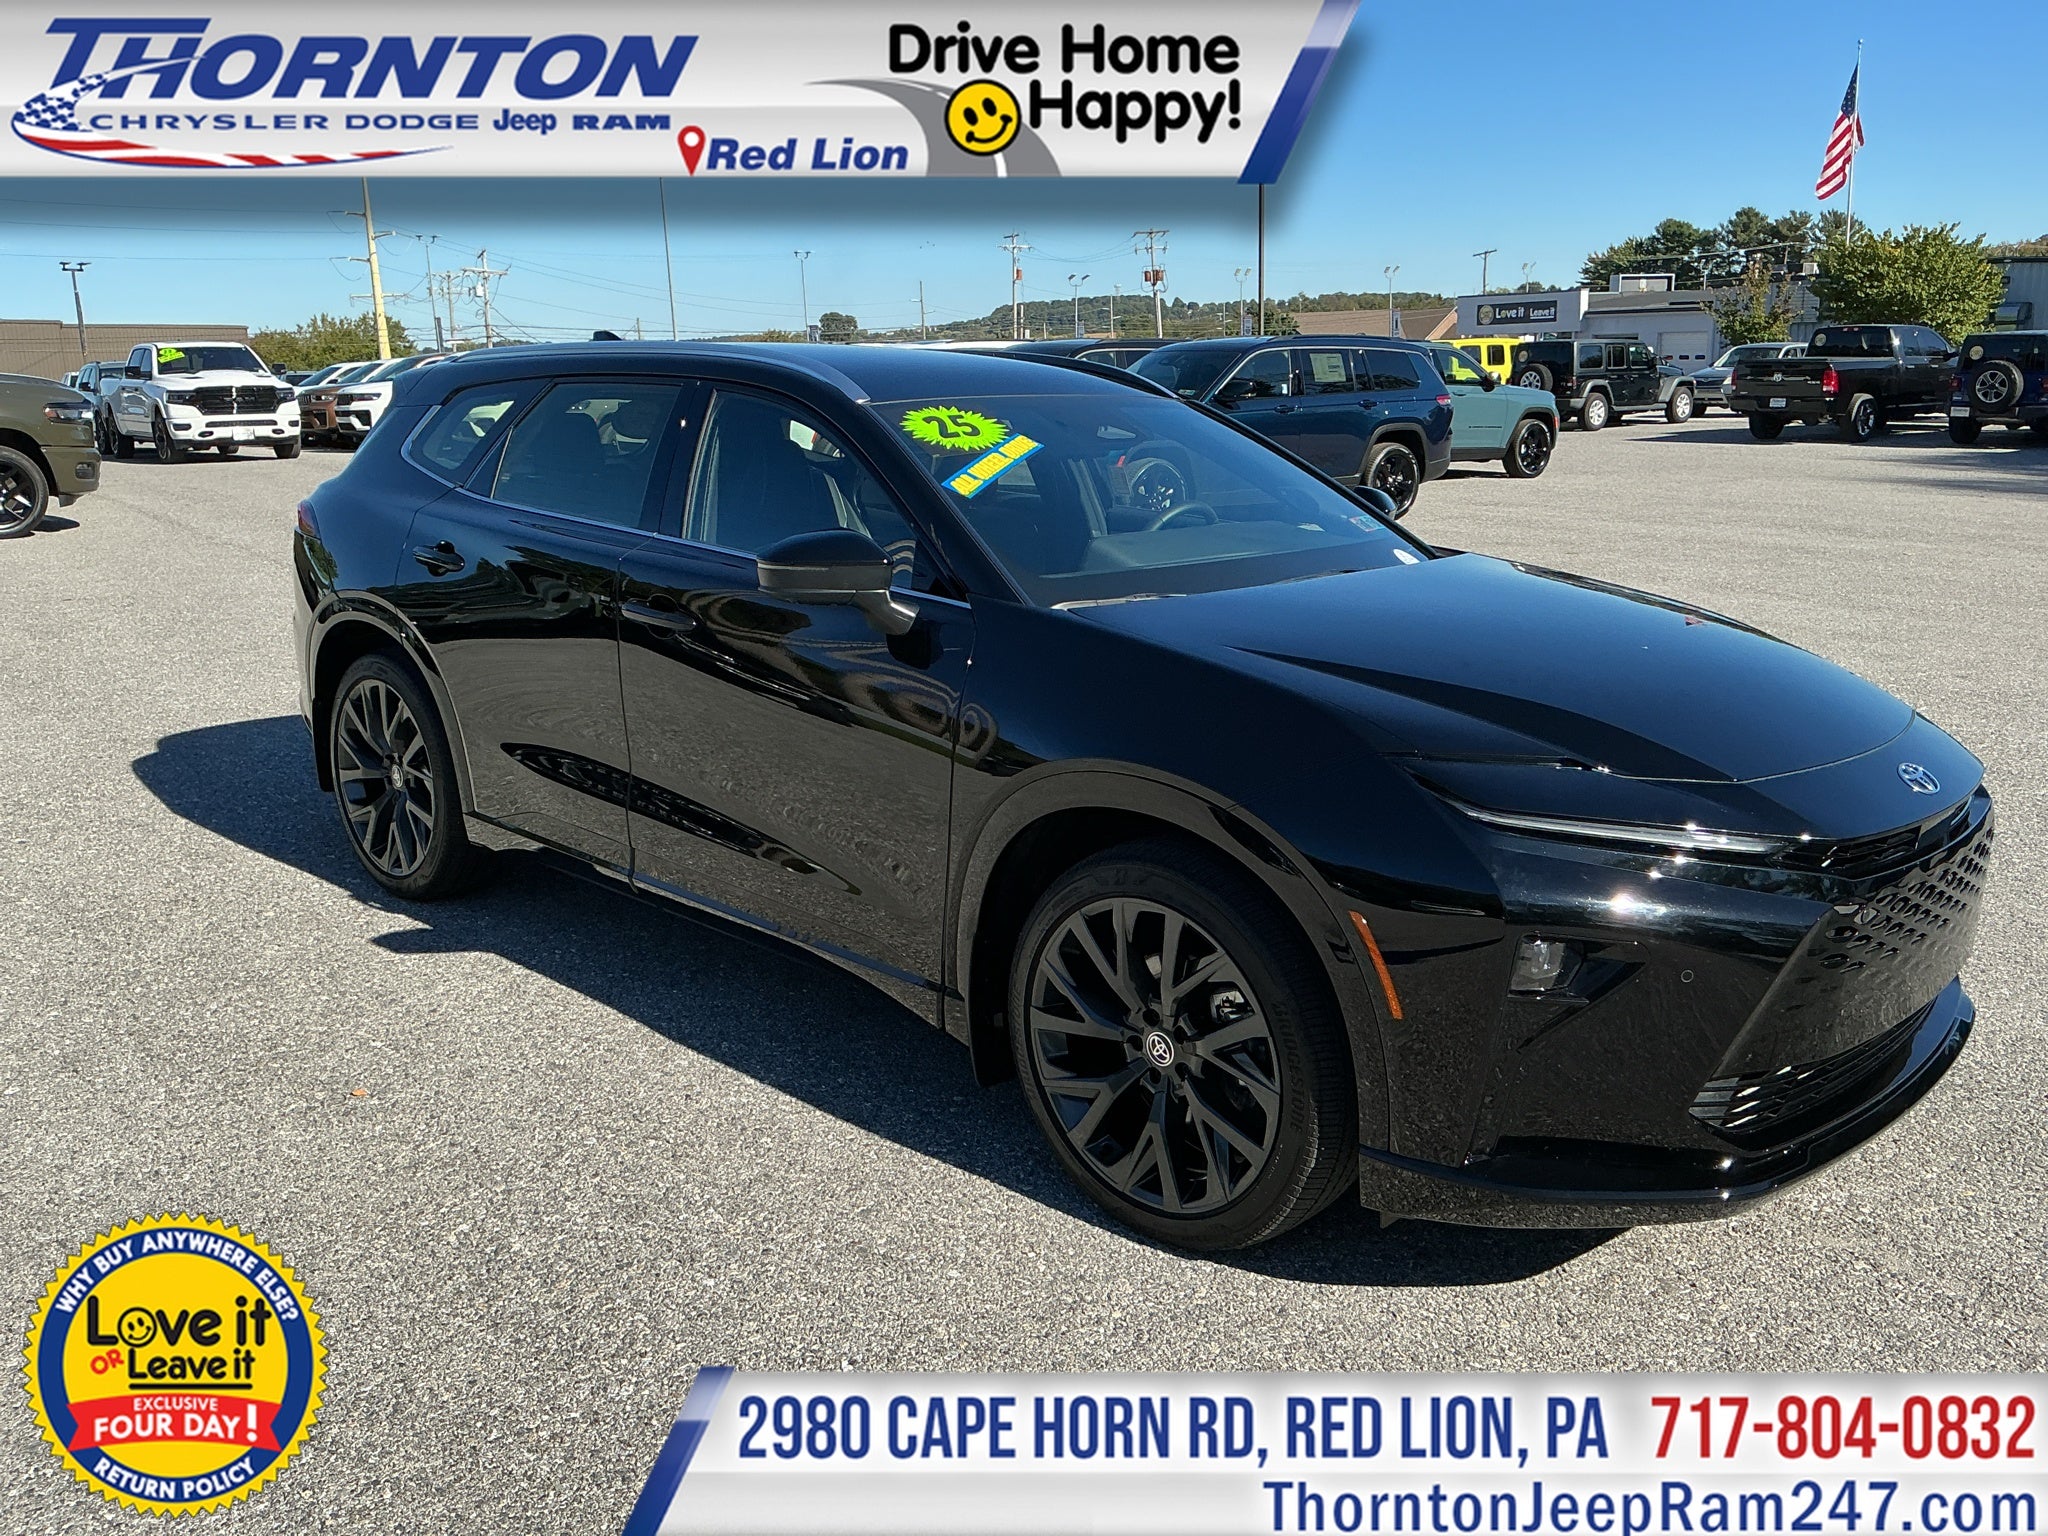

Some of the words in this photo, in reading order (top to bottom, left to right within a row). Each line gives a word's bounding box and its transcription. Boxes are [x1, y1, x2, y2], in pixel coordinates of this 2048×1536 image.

[1495, 307, 1517, 319] Love
[1518, 306, 1525, 318] it
[1529, 307, 1549, 318] Leave
[922, 414, 981, 439] 25
